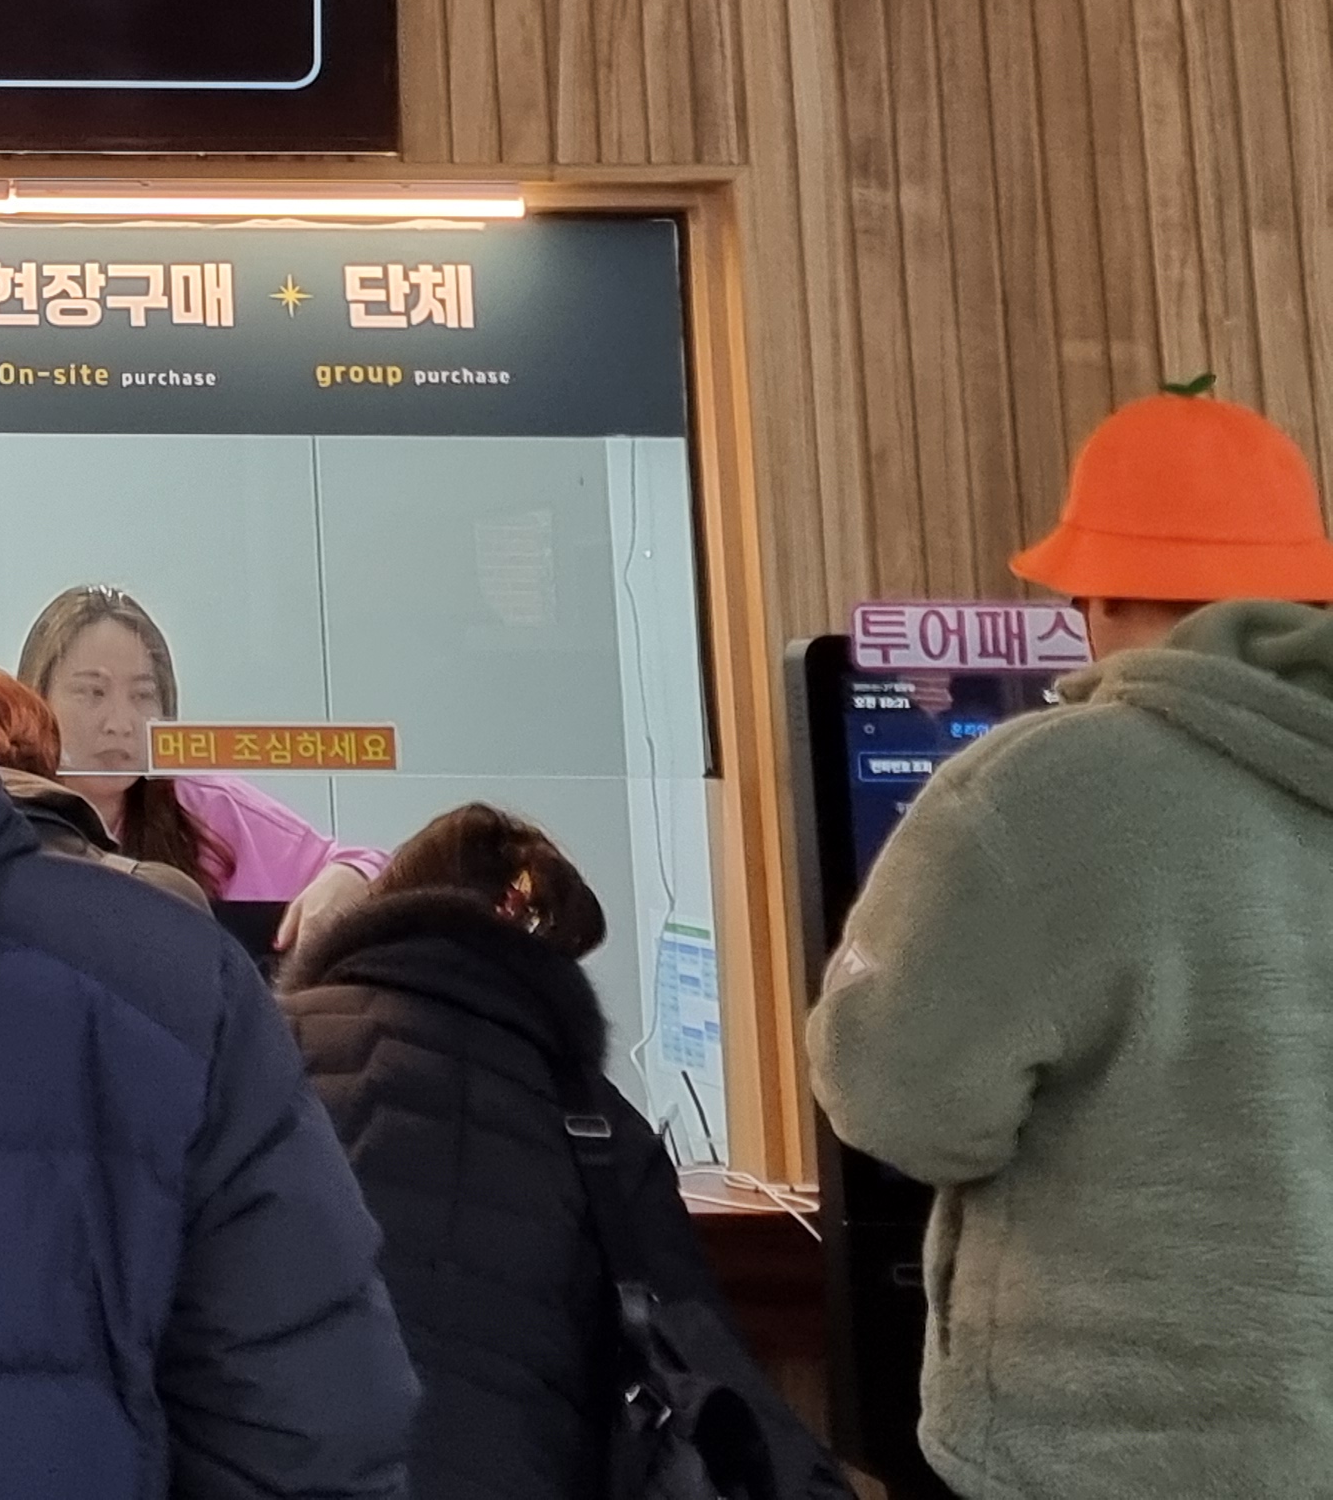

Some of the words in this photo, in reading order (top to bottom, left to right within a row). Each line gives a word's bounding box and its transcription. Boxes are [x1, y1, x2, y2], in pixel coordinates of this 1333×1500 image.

[343, 261, 476, 330] 단체
[121, 368, 217, 390] purchase
[315, 360, 404, 389] group
[413, 366, 512, 386] purchase
[859, 609, 1088, 666] 투어패스
[158, 731, 216, 764] 머리
[233, 731, 391, 766] 조심하세요
